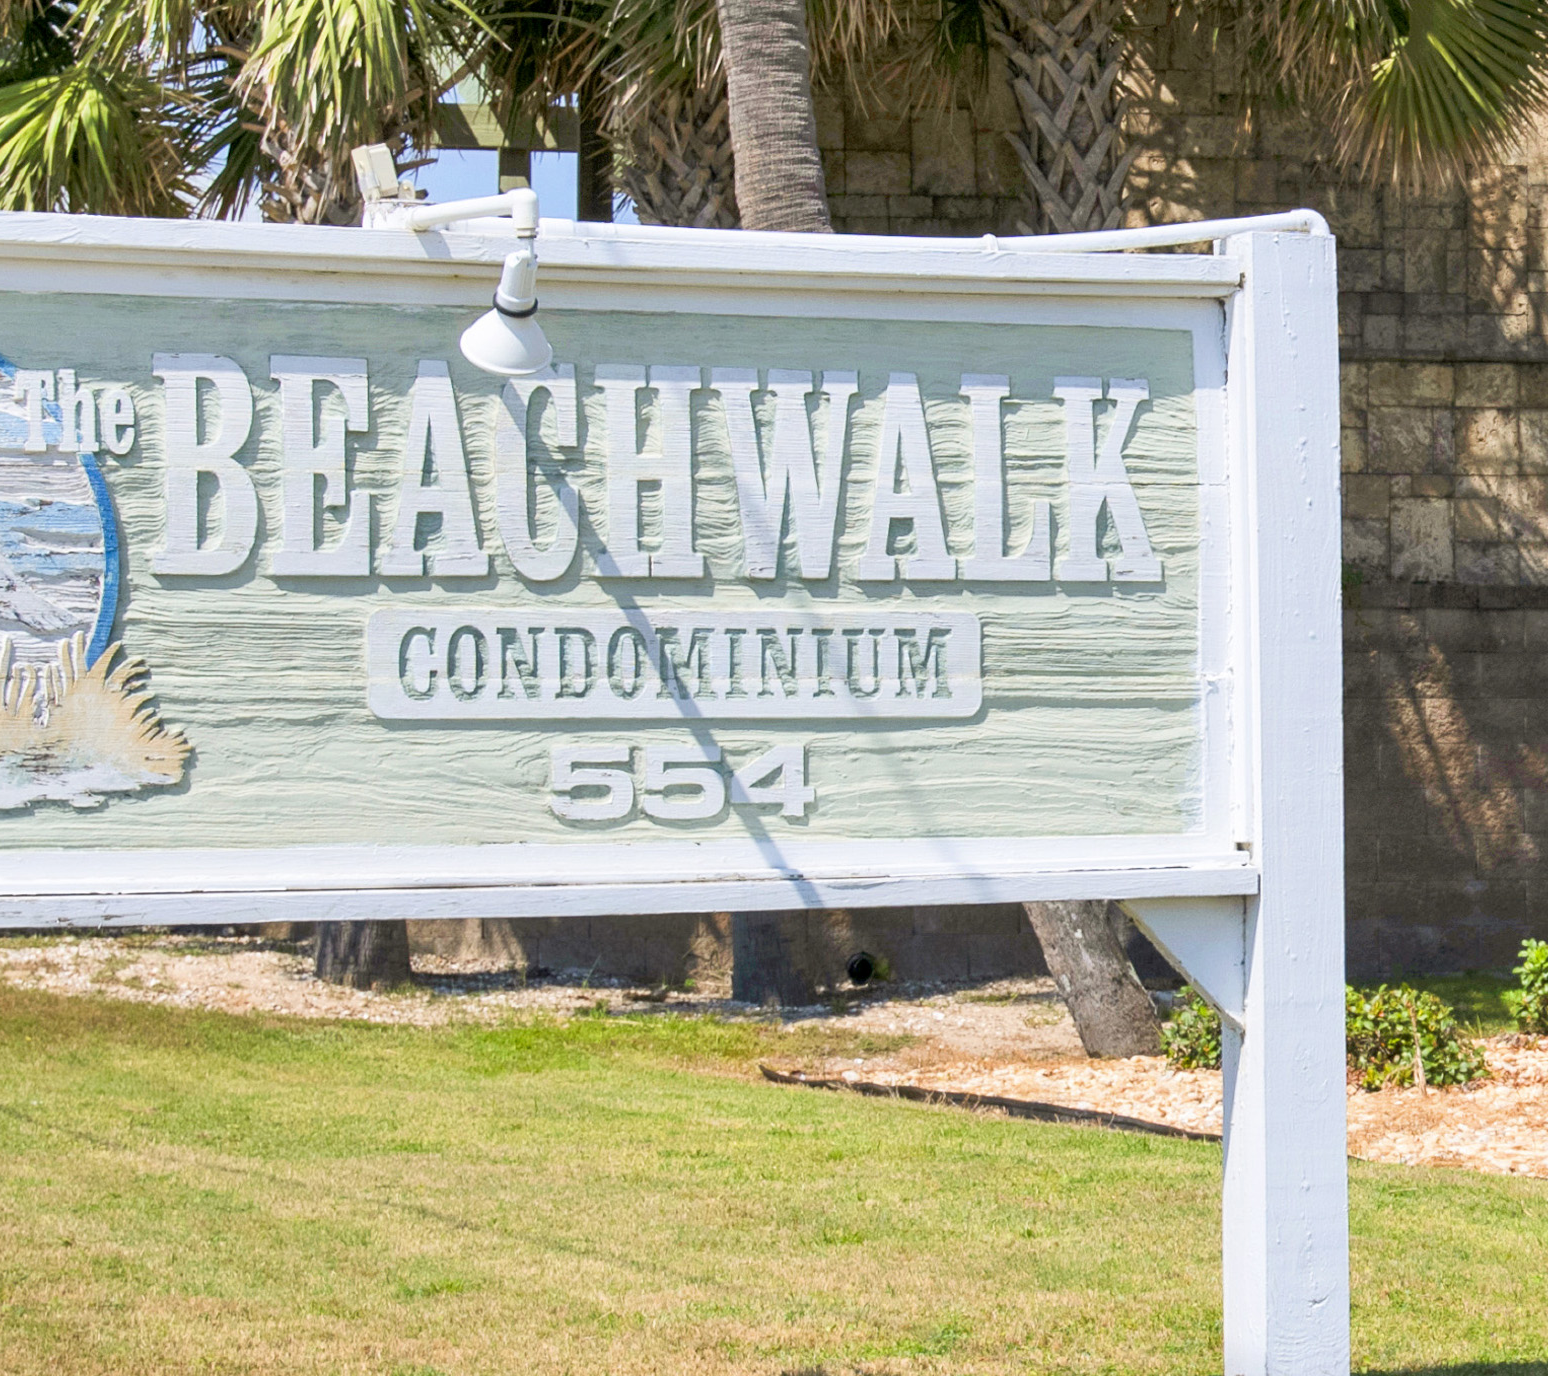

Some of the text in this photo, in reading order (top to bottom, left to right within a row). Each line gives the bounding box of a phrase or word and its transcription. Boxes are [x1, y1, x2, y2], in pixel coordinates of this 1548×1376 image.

[12, 351, 1164, 582] The BEACHWALK
[397, 625, 955, 702] CONDOMINIUM
[550, 742, 817, 824] 554
